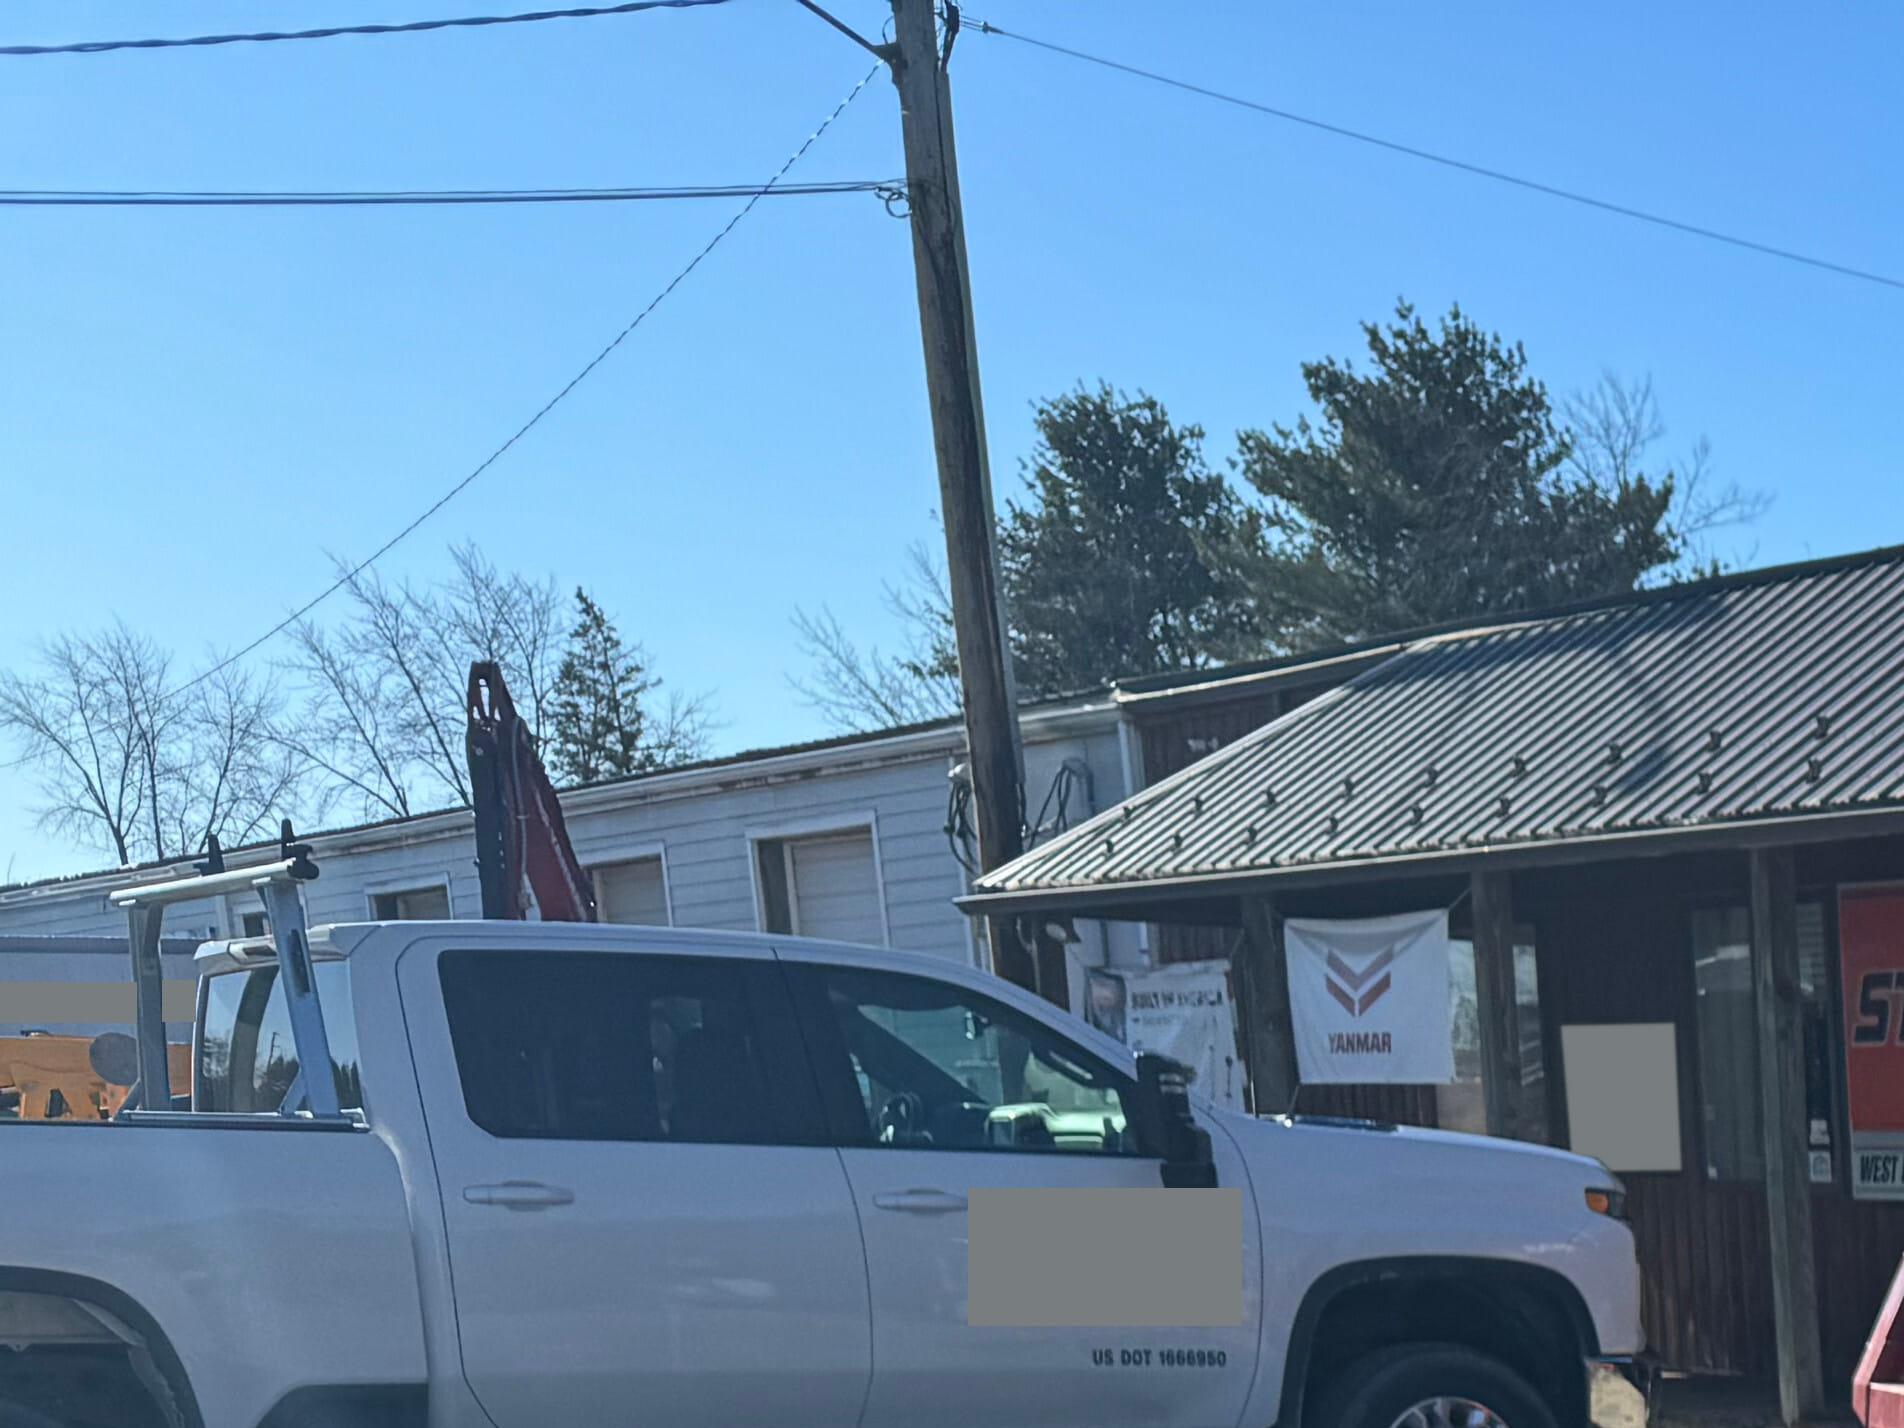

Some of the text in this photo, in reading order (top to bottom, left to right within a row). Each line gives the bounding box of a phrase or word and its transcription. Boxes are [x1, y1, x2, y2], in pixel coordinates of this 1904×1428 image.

[1328, 1032, 1392, 1054] YANMAR
[1859, 1154, 1899, 1183] WEST
[1092, 1348, 1114, 1367] US
[1120, 1348, 1153, 1367] DOT
